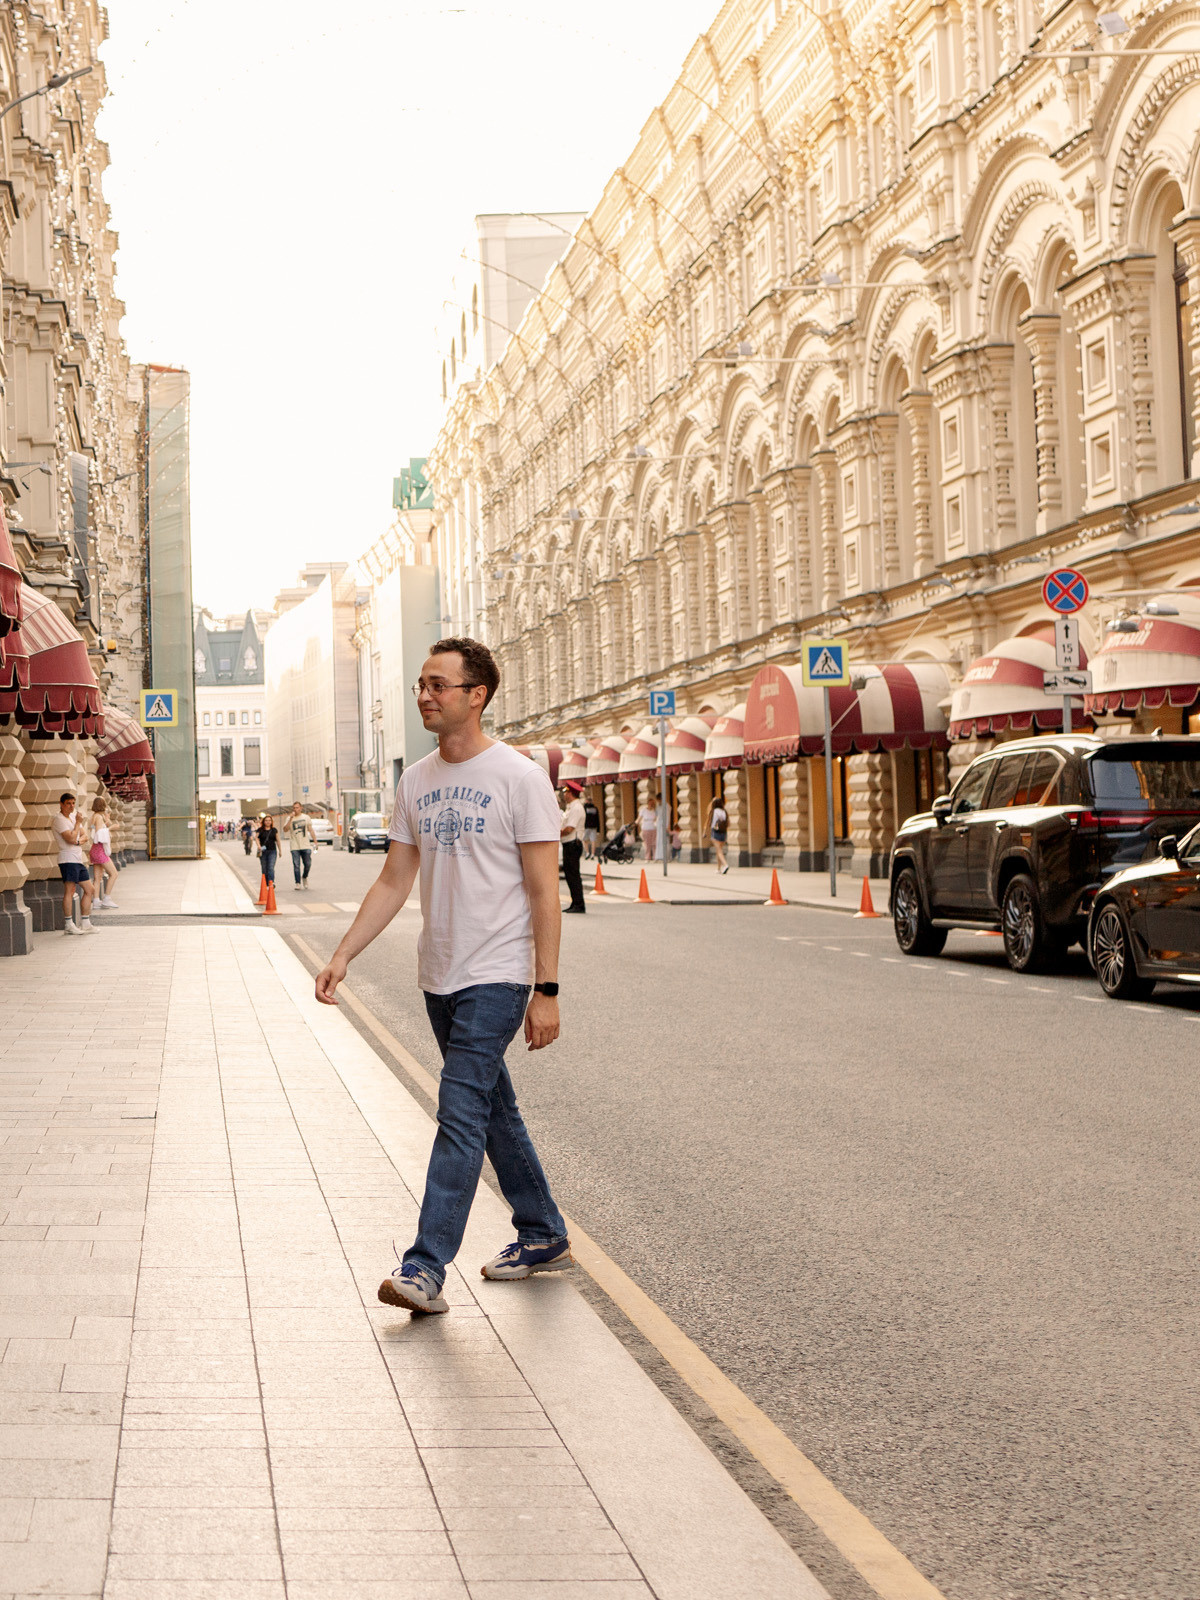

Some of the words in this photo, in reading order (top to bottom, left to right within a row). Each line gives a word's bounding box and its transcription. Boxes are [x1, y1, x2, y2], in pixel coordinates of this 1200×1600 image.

[1062, 644, 1073, 653] 15
[654, 693, 668, 714] P
[417, 789, 441, 810] TOM
[445, 786, 491, 808] TAILOR
[418, 817, 431, 834] 19
[463, 816, 485, 833] 62
